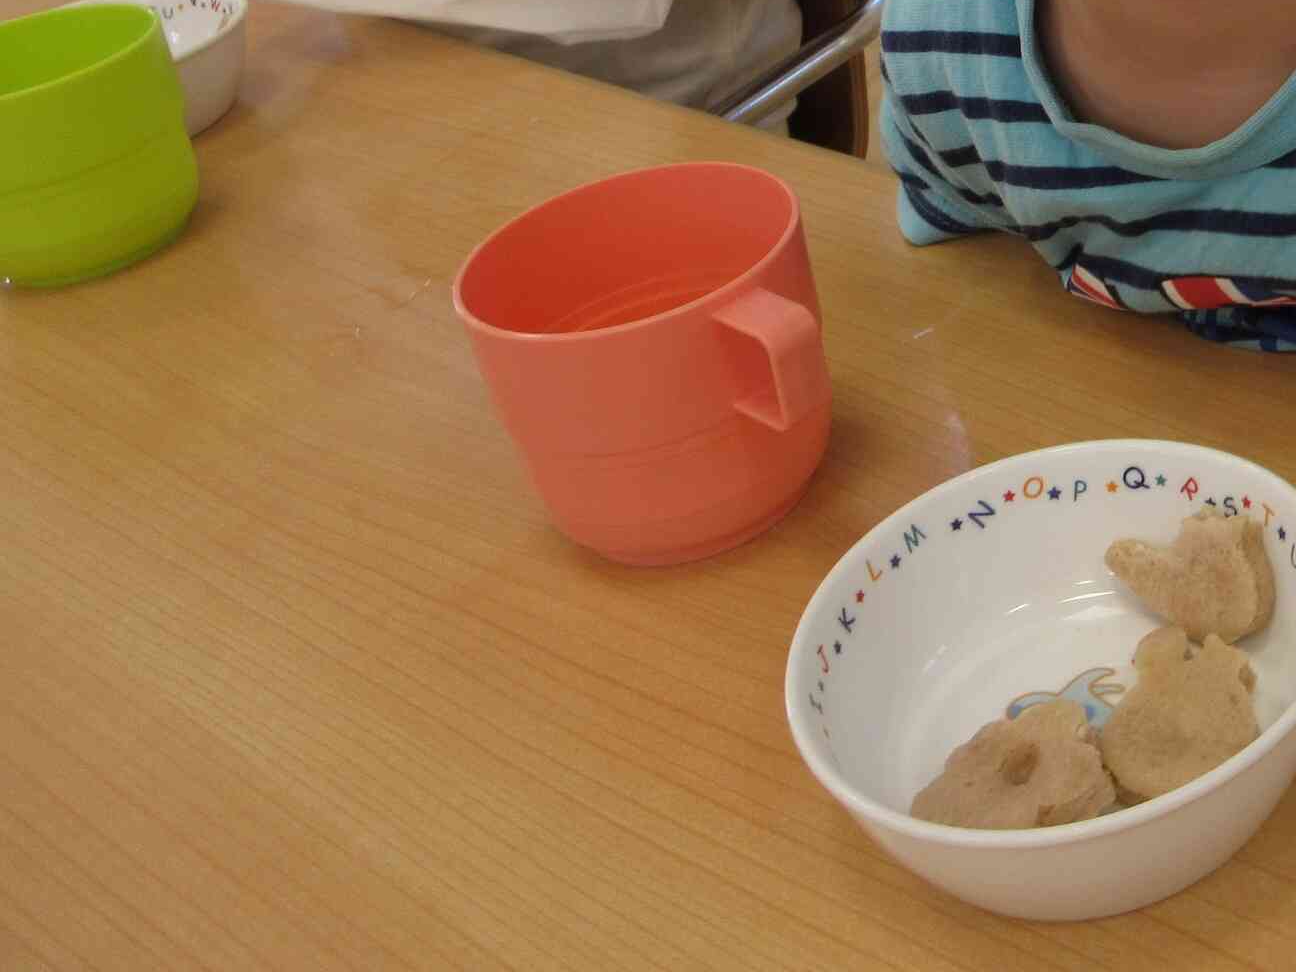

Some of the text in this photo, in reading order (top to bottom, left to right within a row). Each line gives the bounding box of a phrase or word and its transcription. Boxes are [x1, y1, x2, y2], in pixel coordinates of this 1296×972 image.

[837, 607, 855, 633] K
[865, 558, 882, 581] L
[903, 524, 926, 553] M
[967, 499, 996, 528] N
[1023, 476, 1044, 499] O
[1073, 480, 1087, 502] P
[1122, 466, 1150, 490] Q
[1180, 477, 1199, 501] R
[1223, 496, 1238, 518] S
[1262, 502, 1276, 526] T
